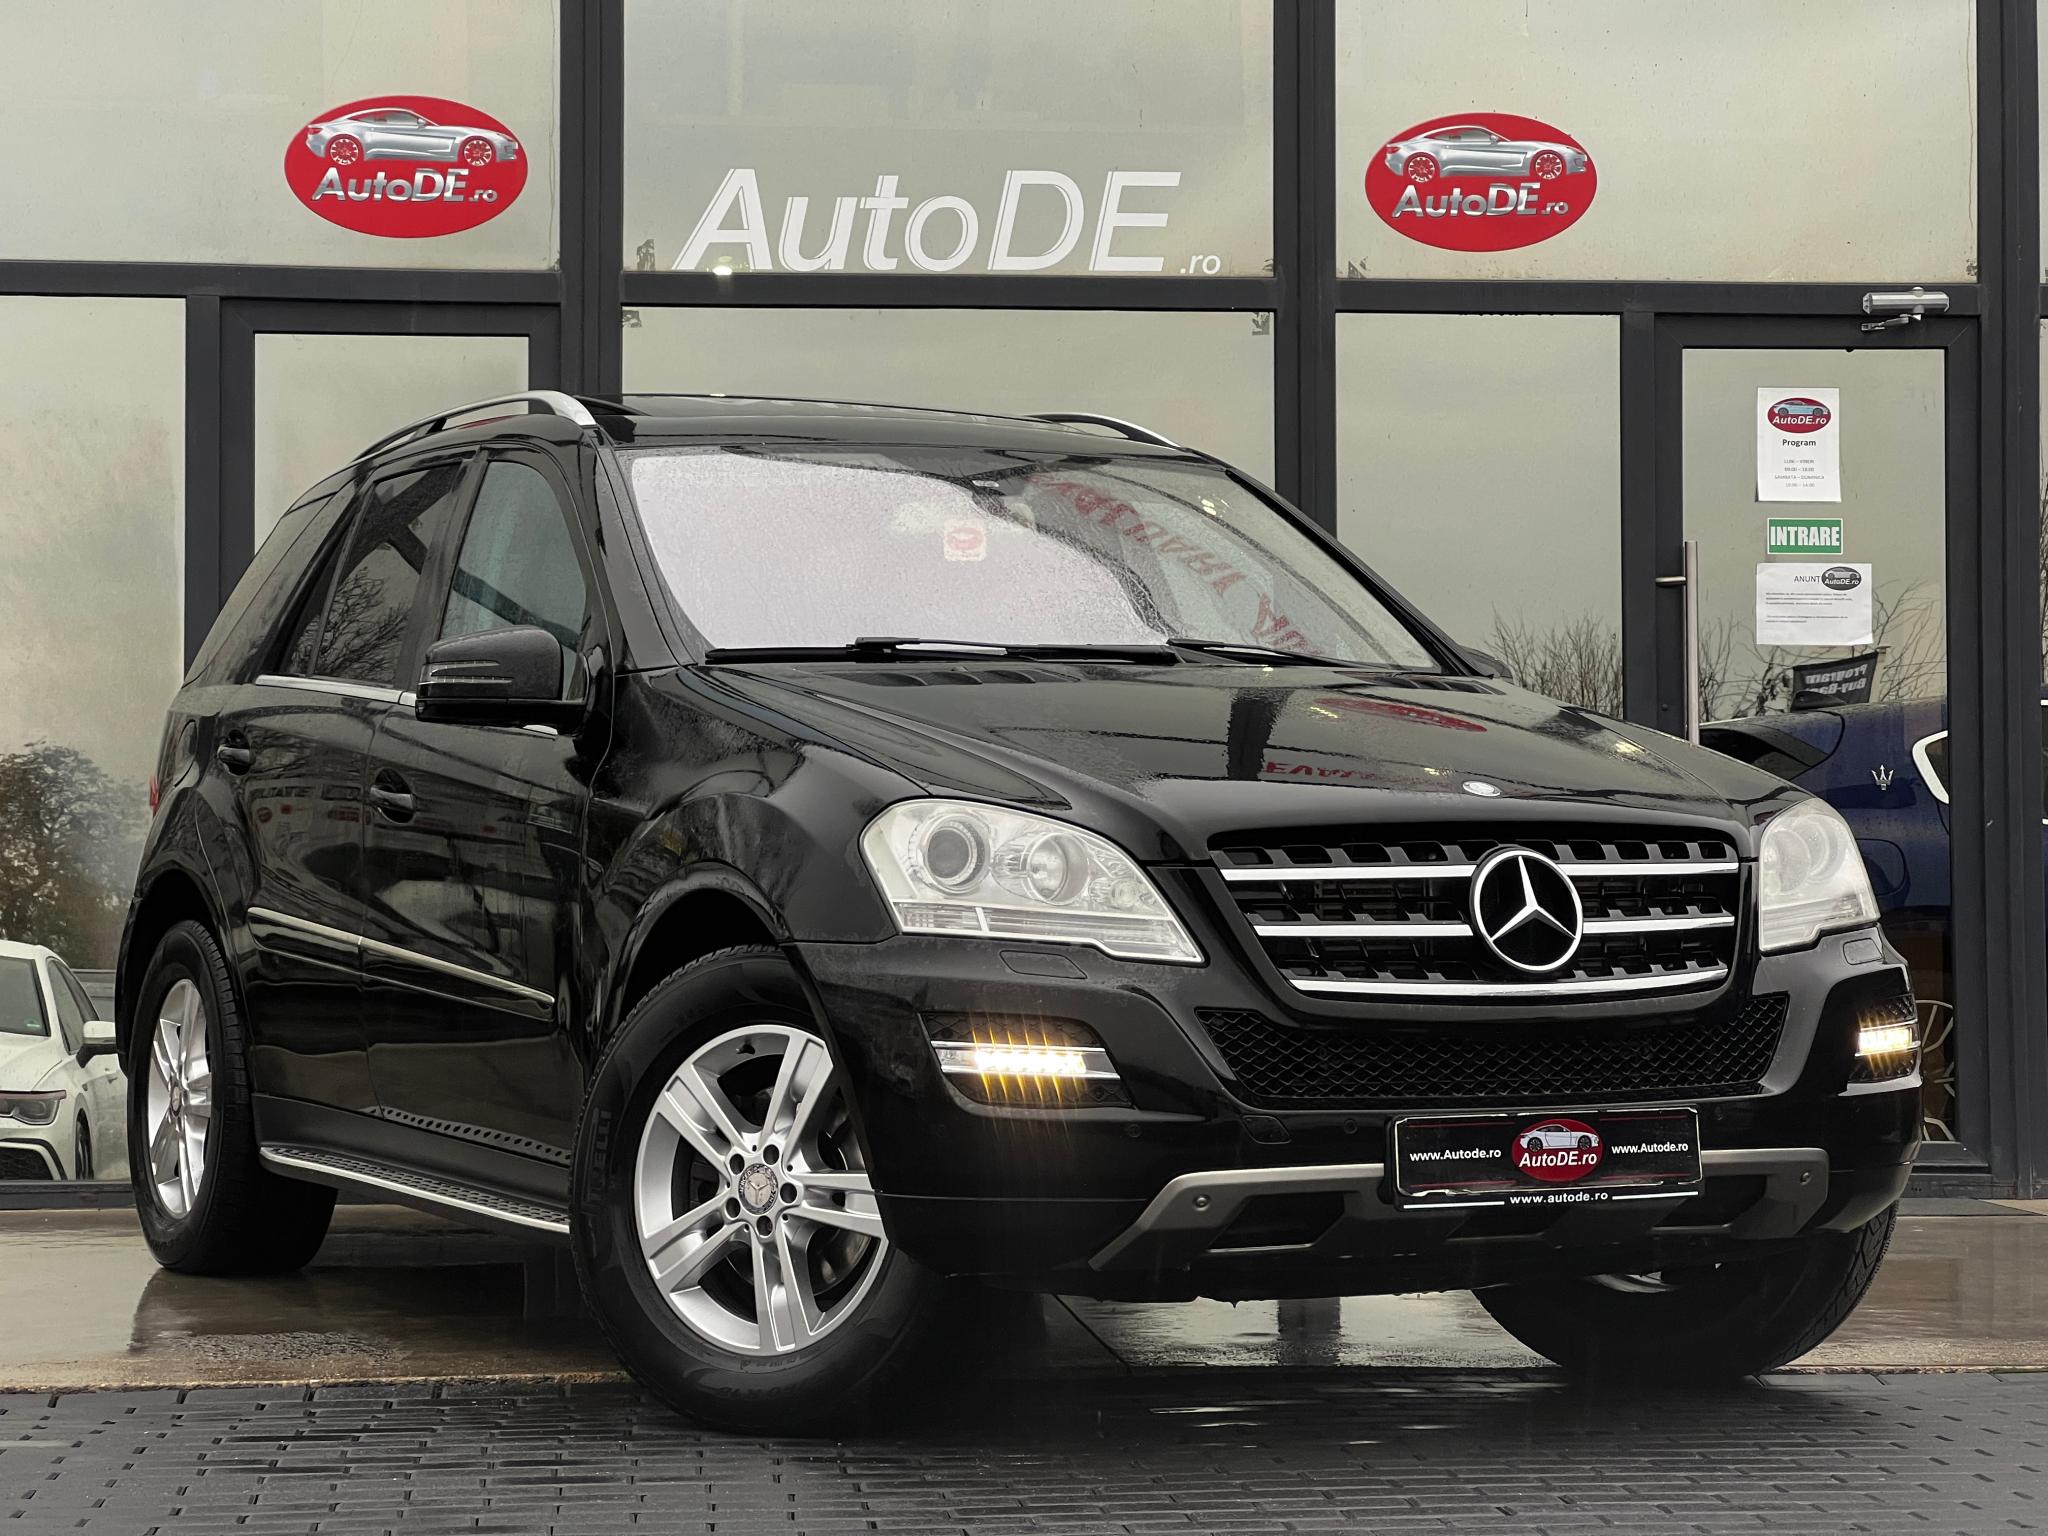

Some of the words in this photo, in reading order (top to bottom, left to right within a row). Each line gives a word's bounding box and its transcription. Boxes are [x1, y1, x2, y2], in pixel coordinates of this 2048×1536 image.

[1772, 415, 1827, 425] AutoDE.ro
[1782, 439, 1817, 448] Program
[1770, 526, 1840, 546] INTRARE
[1409, 1147, 1502, 1162] www.Autode.ro
[1611, 1142, 1689, 1155] www.Autode.ro
[1518, 1151, 1598, 1168] AutoDE.ro
[1509, 1191, 1609, 1205] www.autode.ro
